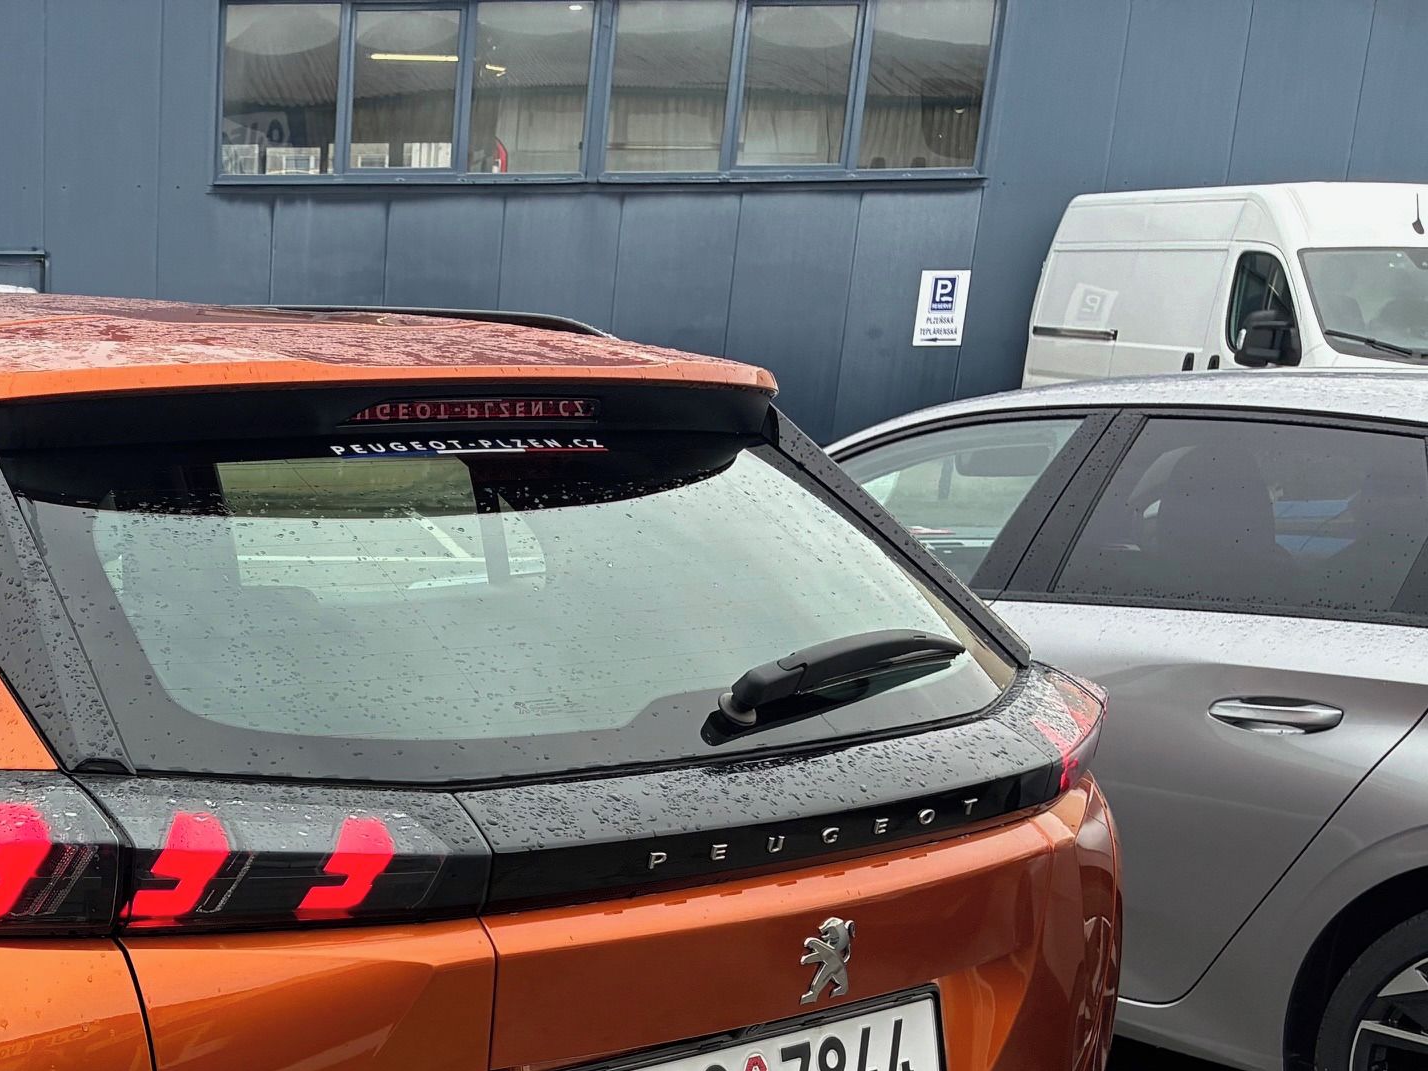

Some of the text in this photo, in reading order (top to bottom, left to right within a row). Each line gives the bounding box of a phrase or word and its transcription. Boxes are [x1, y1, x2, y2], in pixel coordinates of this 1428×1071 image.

[935, 280, 952, 302] P
[329, 438, 605, 456] PEUGEOT-PLZEN.CZ
[647, 798, 978, 870] PEUGEOT
